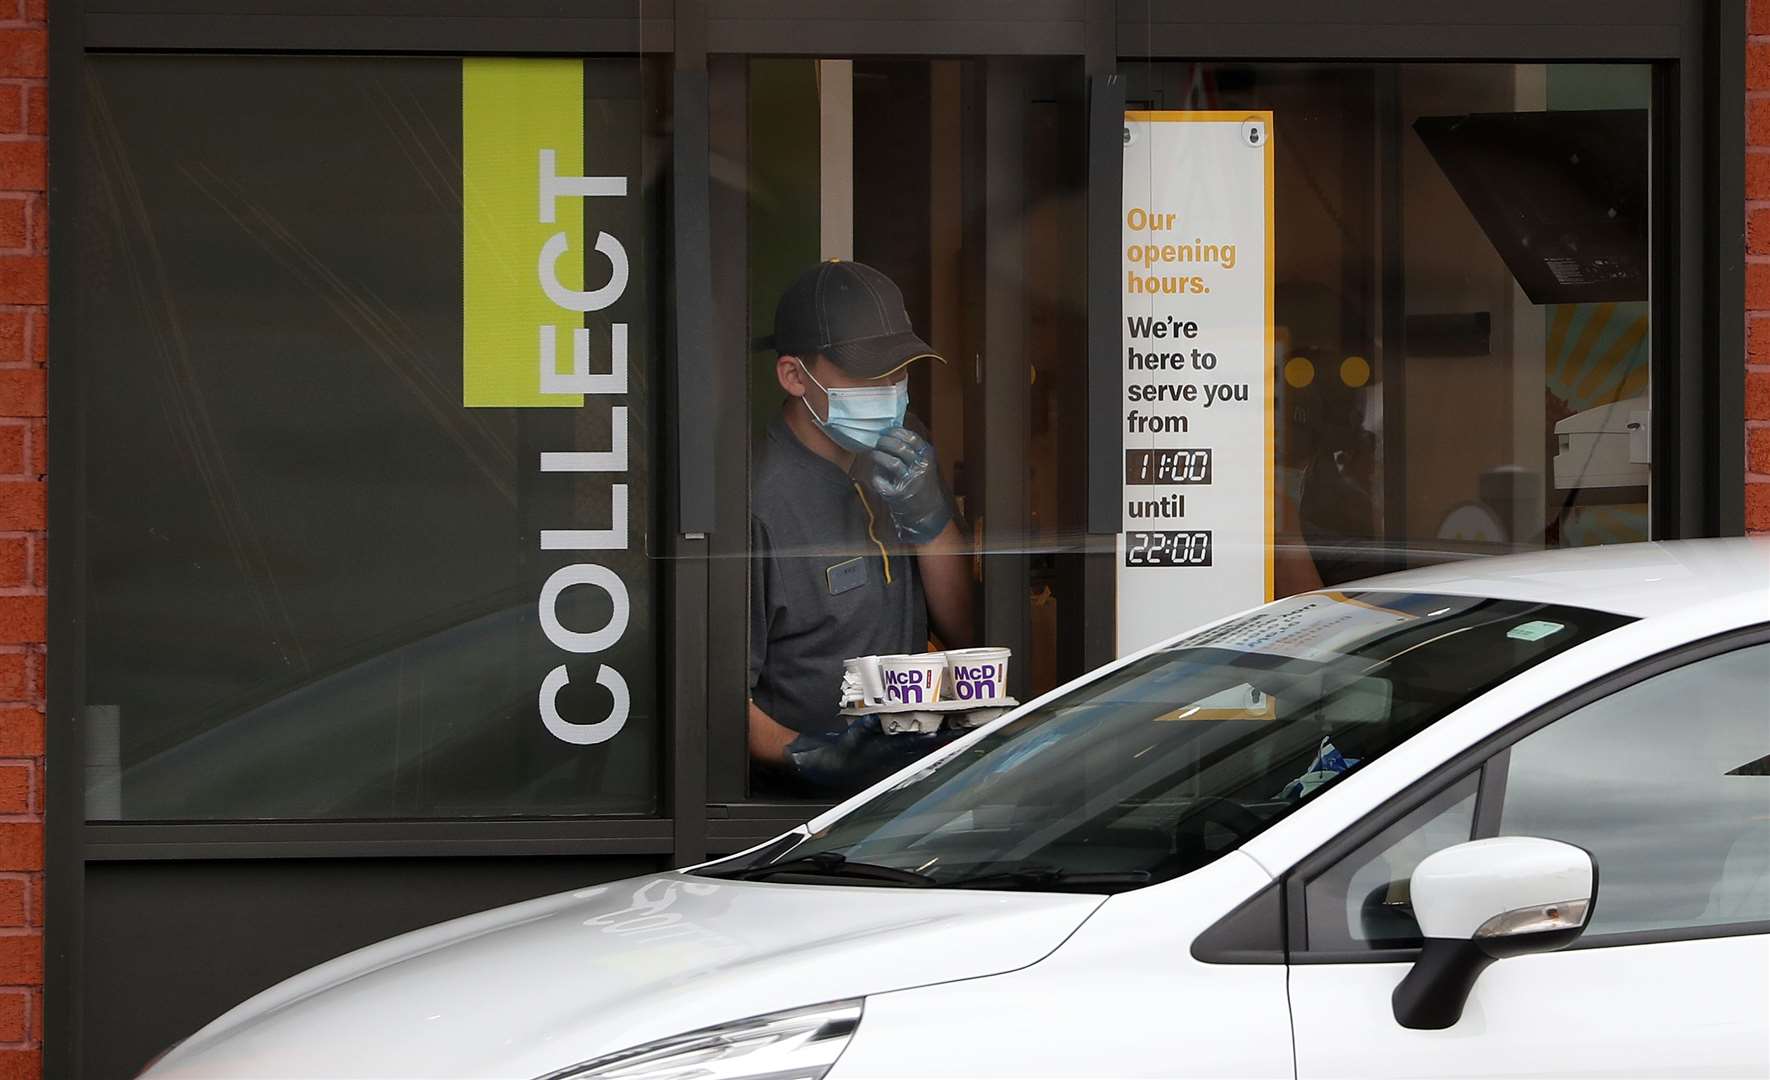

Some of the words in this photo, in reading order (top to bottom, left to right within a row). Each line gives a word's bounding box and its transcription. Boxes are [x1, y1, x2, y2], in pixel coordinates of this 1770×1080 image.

[1127, 208, 1176, 231] Our
[1127, 239, 1236, 268] opening
[1127, 271, 1210, 293] hours.
[1127, 316, 1198, 338] We’re
[1127, 347, 1185, 370] here
[1191, 348, 1217, 370] to
[1127, 384, 1198, 402] serve
[1203, 384, 1248, 407] you
[1127, 410, 1188, 433] from
[538, 148, 630, 746] COLLECT
[1141, 452, 1208, 481] 11:00
[1127, 494, 1185, 518] until
[1129, 533, 1208, 564] 22:00
[885, 669, 923, 685] McD
[954, 664, 996, 681] McD
[956, 680, 996, 700] on
